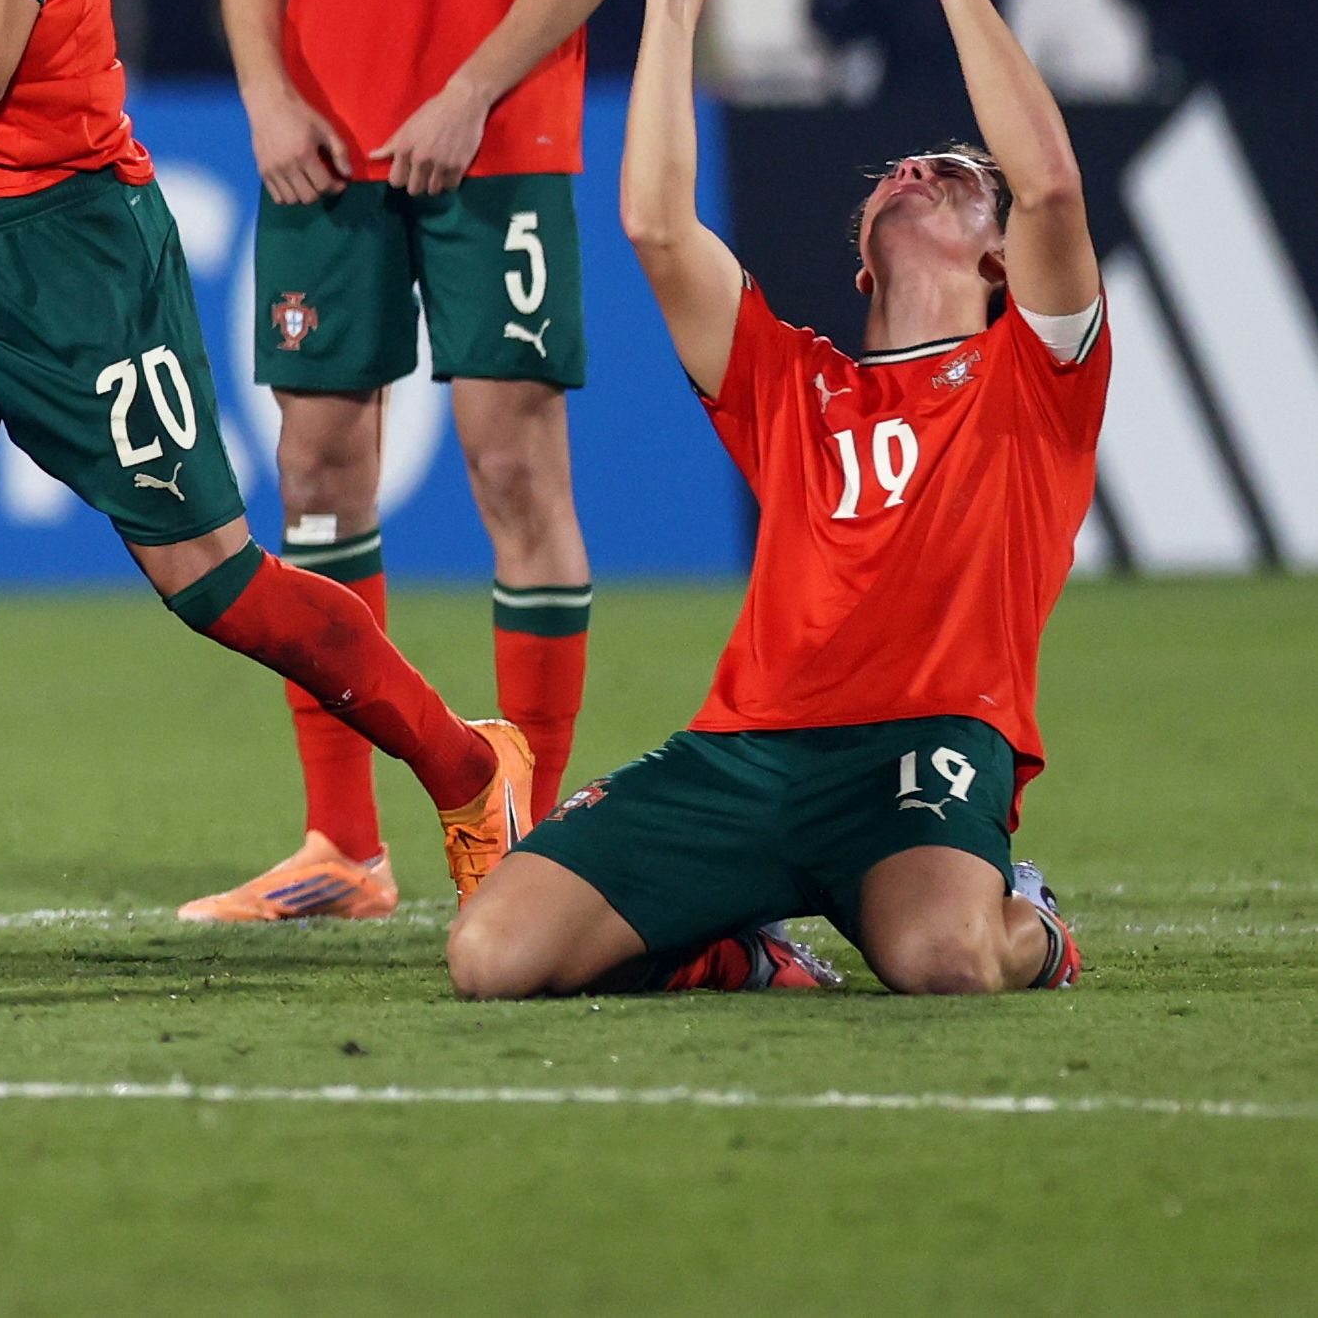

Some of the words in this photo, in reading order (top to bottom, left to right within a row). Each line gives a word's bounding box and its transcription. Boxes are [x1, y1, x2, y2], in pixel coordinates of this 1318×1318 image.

[504, 211, 547, 314] 5
[95, 344, 197, 468] 20
[831, 418, 919, 519] 19
[895, 746, 976, 802] 19
